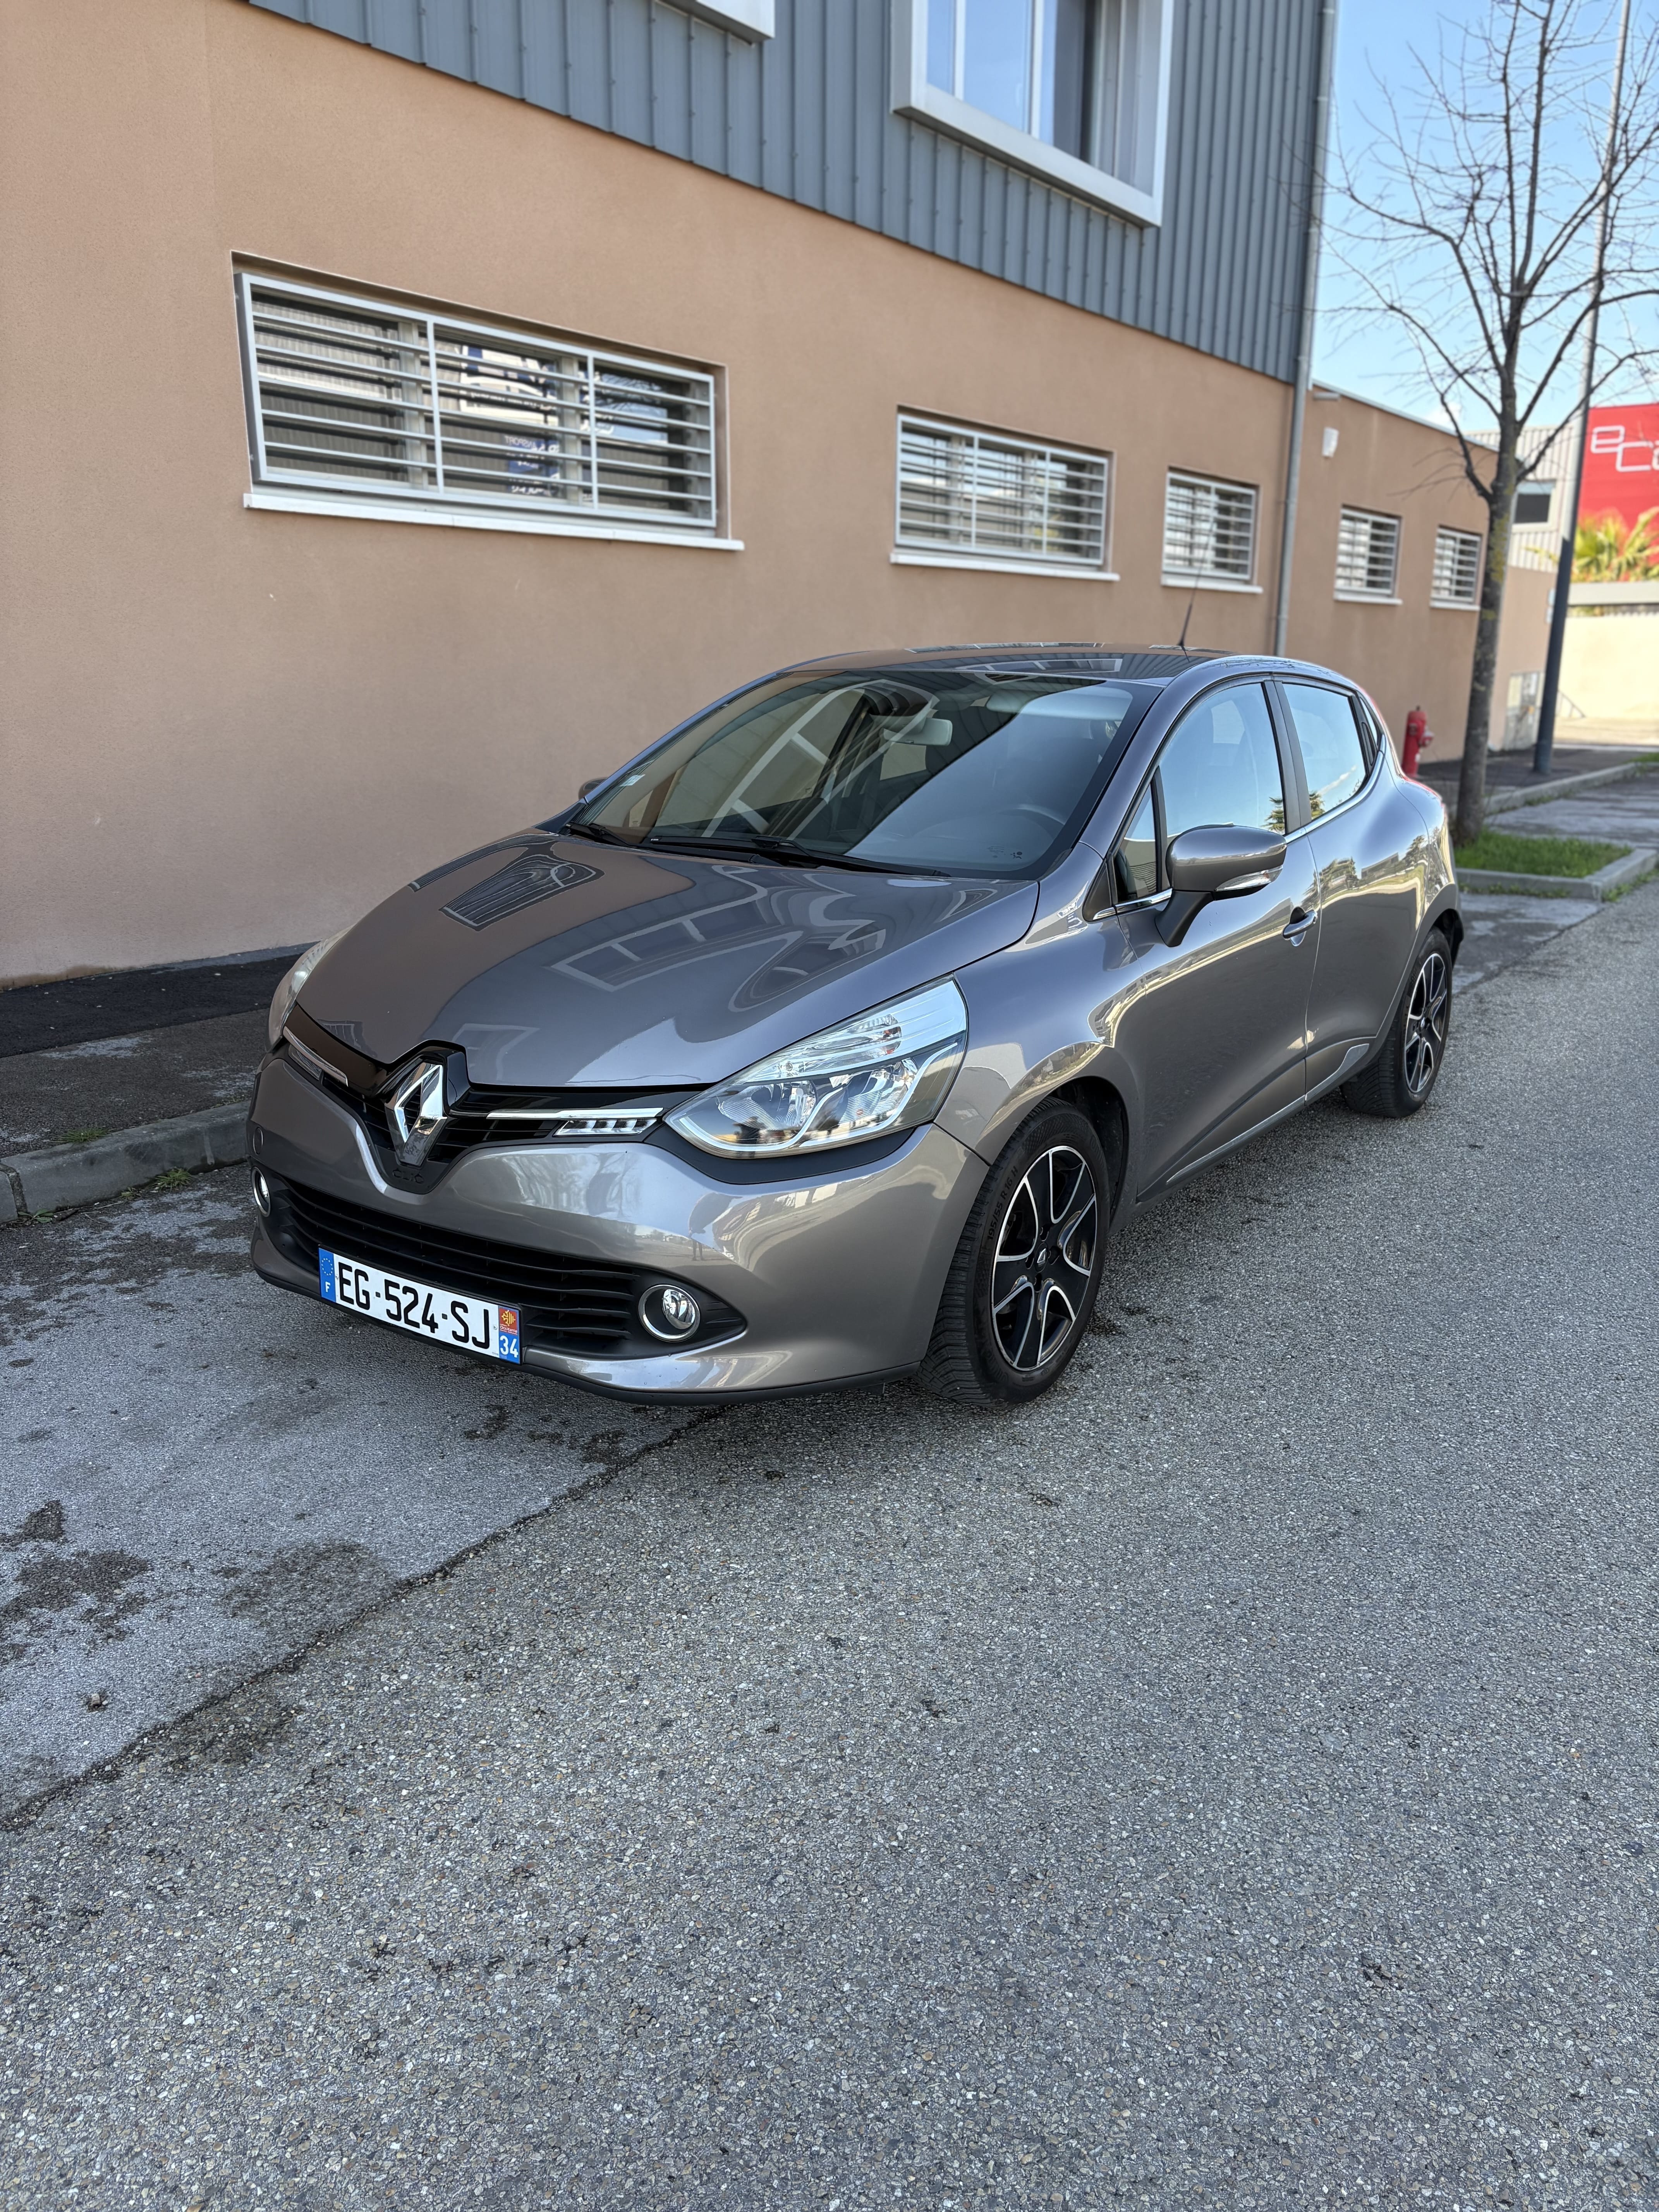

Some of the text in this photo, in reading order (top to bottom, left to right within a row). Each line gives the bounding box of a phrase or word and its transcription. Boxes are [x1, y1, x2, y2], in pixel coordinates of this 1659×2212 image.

[988, 1202, 1003, 1239] 195/55
[1011, 1166, 1018, 1176] H
[325, 1281, 331, 1292] F
[500, 1325, 518, 1333] Occitanie
[500, 1335, 519, 1358] 34
